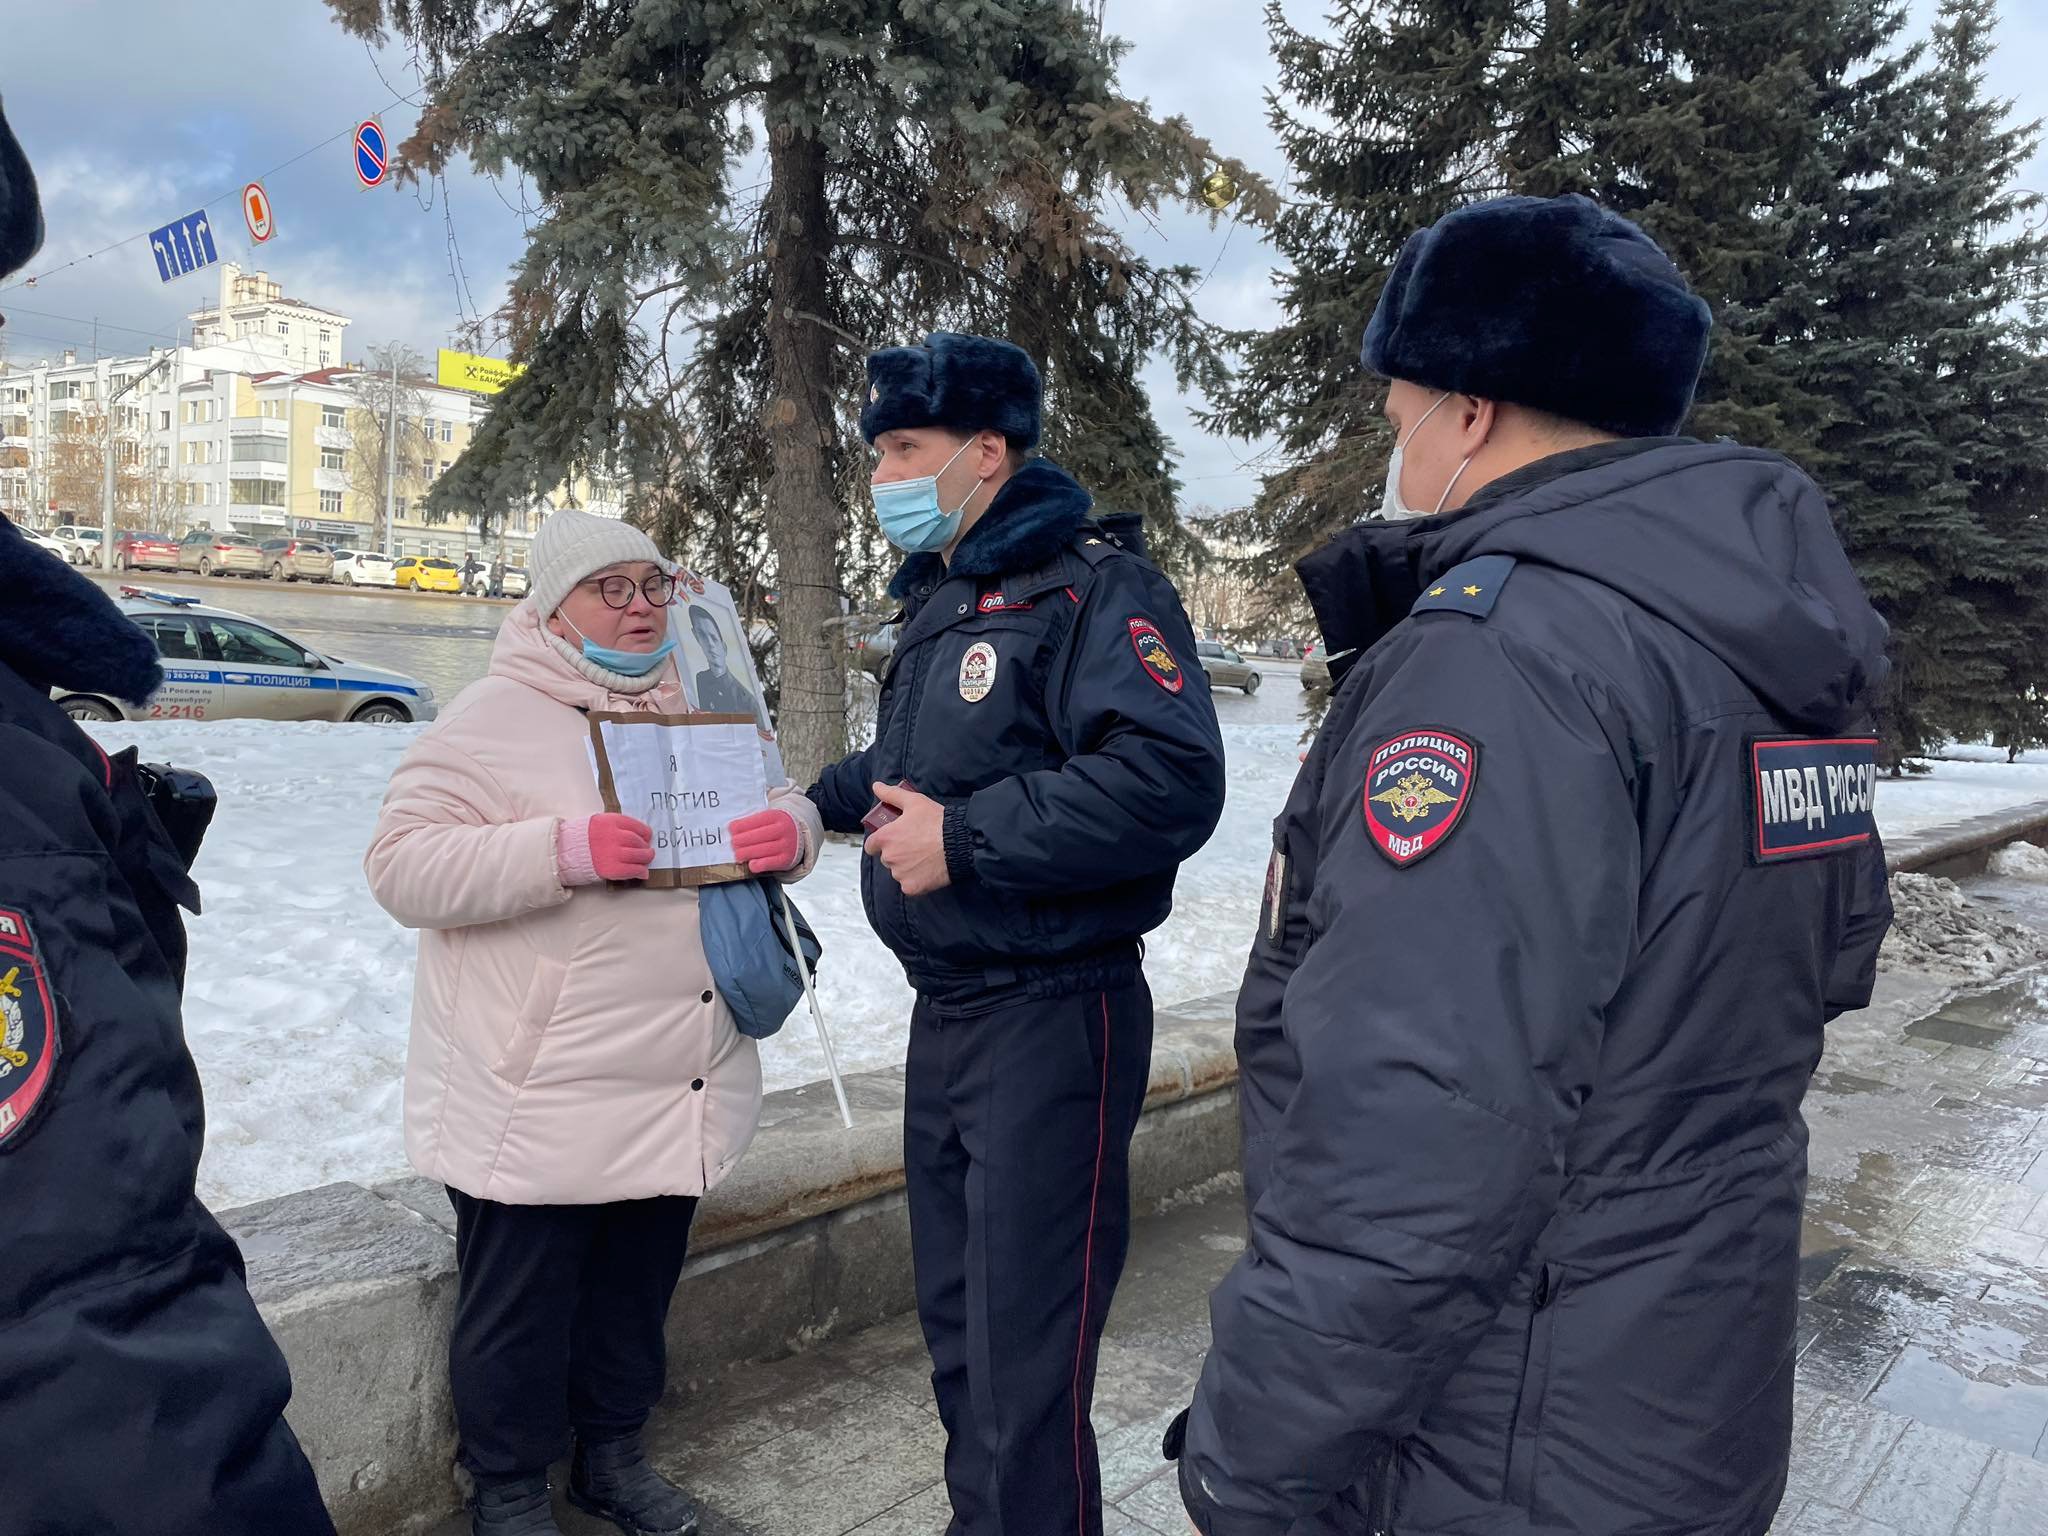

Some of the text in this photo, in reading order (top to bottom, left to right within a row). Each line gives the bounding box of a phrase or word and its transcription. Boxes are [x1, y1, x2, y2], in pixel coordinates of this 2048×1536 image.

[253, 674, 311, 687] ПОЛИЦИЯ
[150, 704, 205, 718] 2-216
[1375, 737, 1467, 764] ПОЛИЦИЯ
[669, 754, 678, 773] Я
[1375, 757, 1458, 787] РОССИЯ
[1760, 763, 1876, 831] МВД РОССИ
[657, 825, 722, 849] ВОЙНЫ
[1388, 834, 1424, 857] МВД
